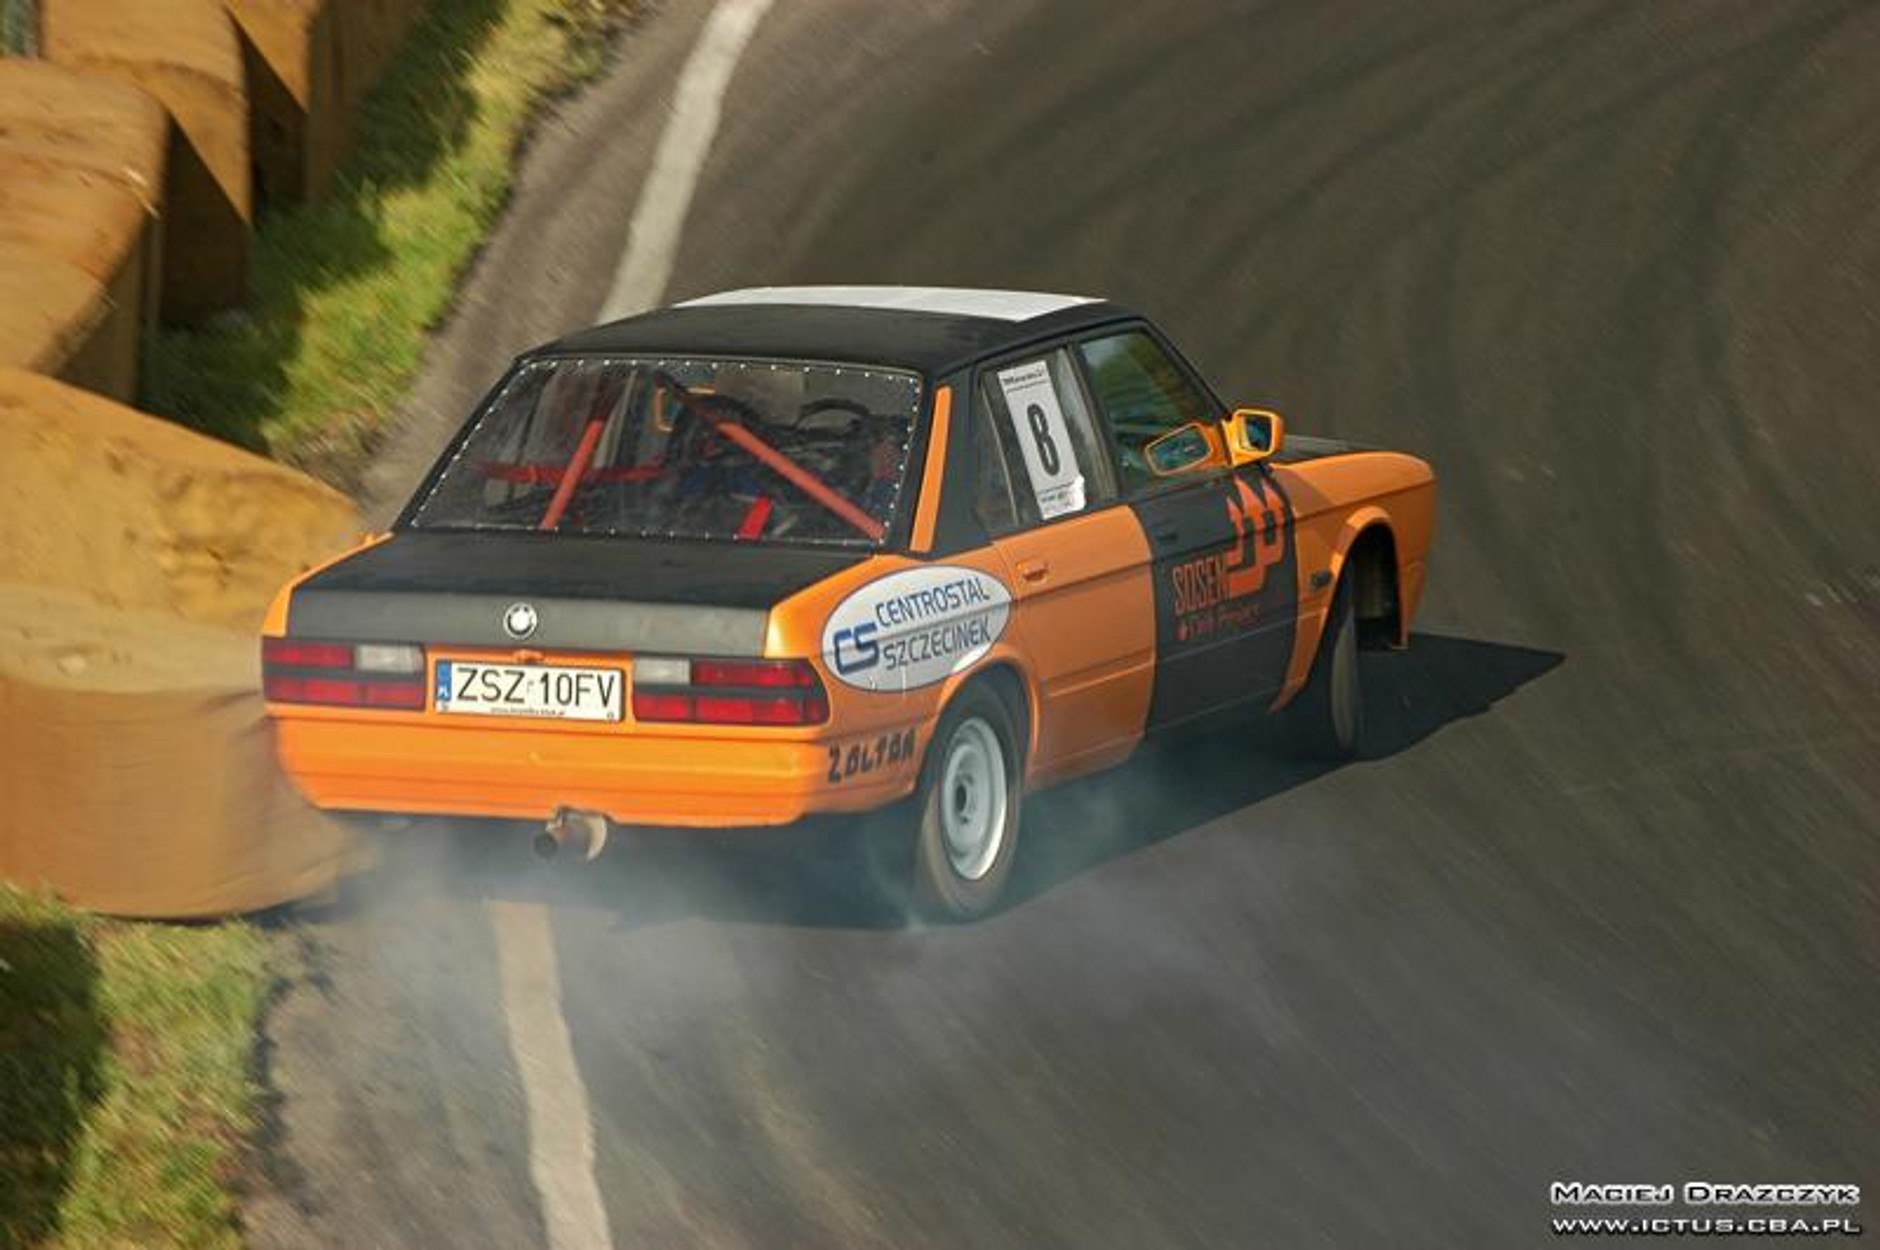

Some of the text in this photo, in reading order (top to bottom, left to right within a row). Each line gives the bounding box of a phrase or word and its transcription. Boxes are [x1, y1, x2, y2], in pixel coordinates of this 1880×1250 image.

[1027, 403, 1060, 476] 8
[876, 577, 990, 627] CENTROSTAL
[833, 622, 879, 675] CS
[882, 616, 991, 670] SZCZECINEK
[456, 667, 615, 707] ZSZ 10FV
